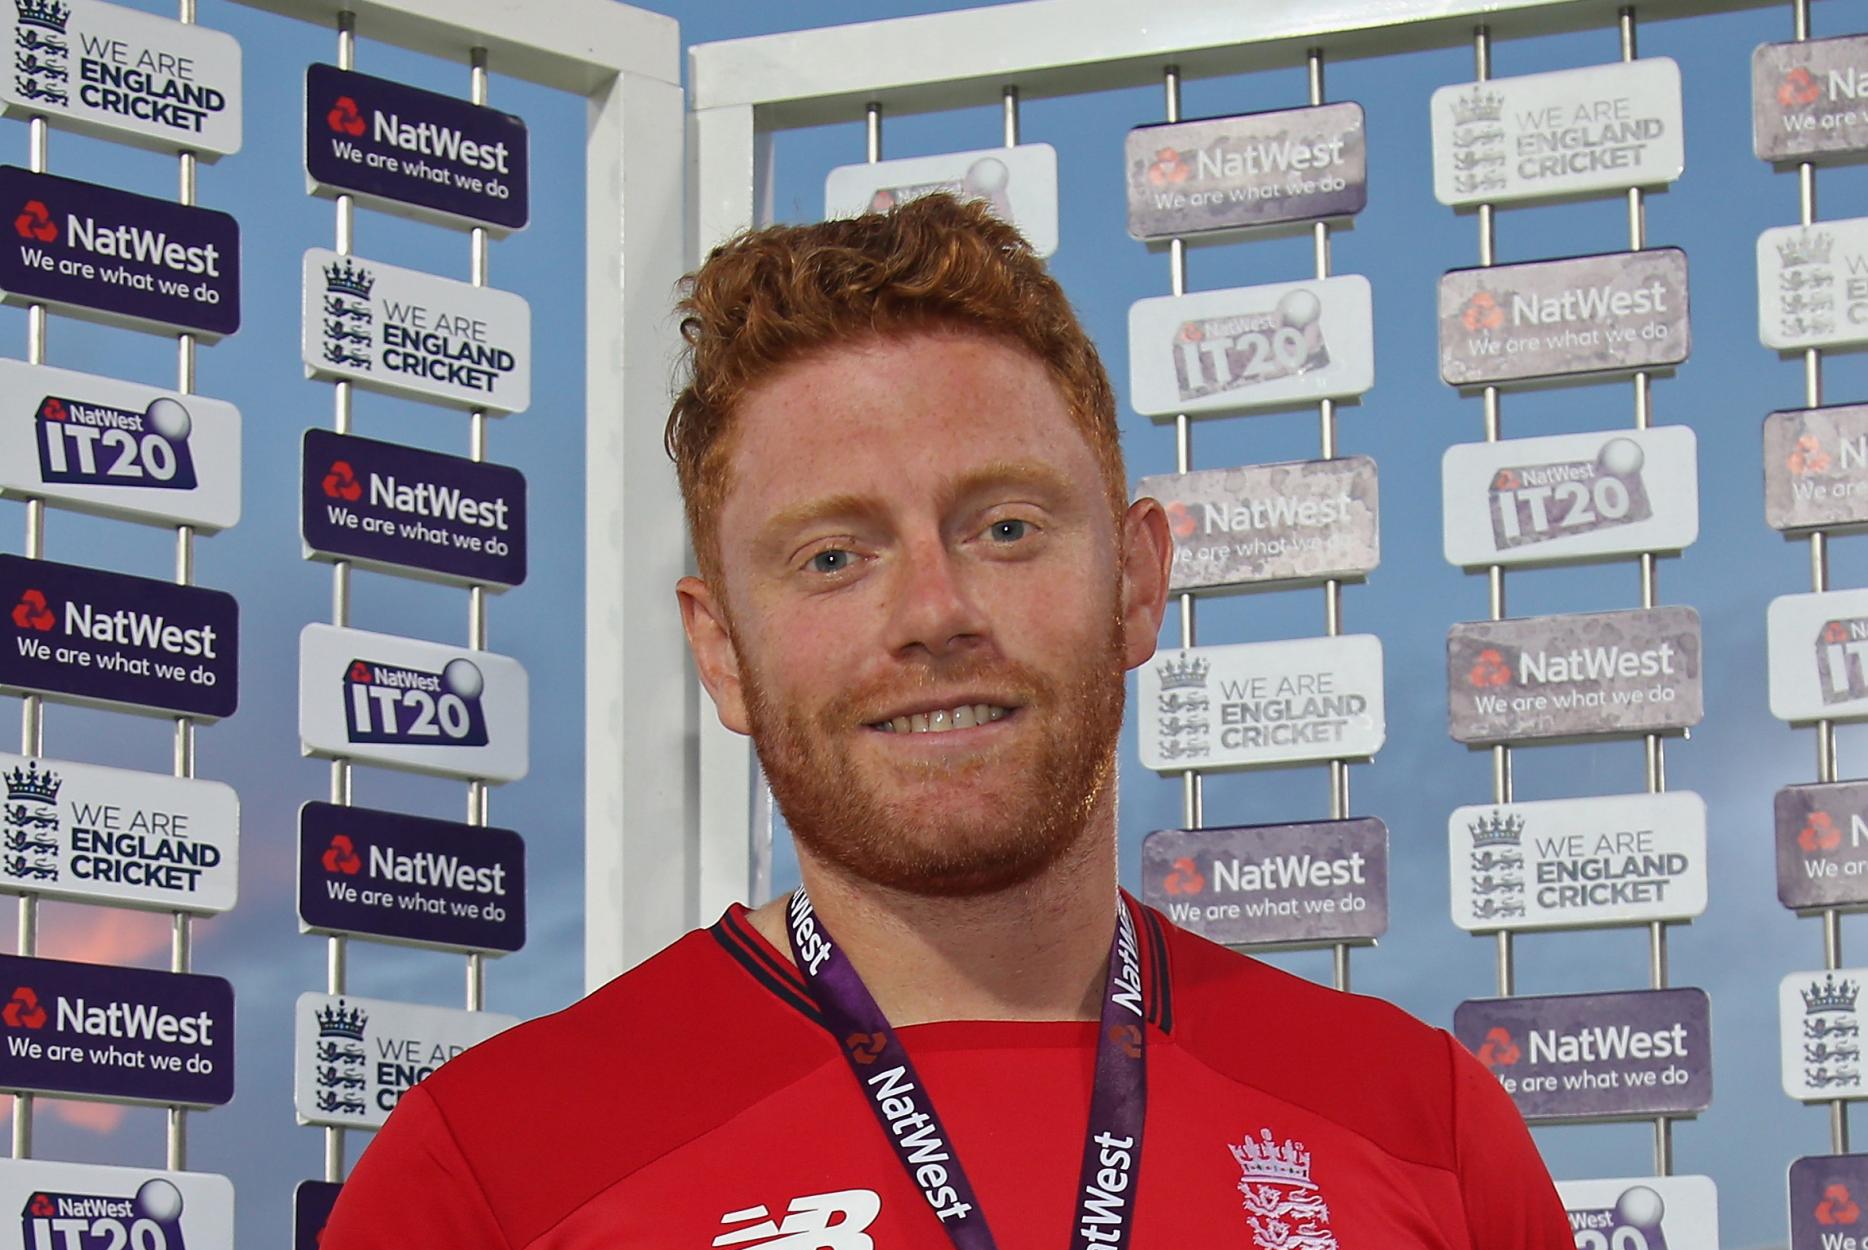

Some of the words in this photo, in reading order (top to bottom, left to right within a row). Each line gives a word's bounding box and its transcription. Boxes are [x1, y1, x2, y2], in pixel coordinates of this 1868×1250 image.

[81, 33, 127, 65] WE
[137, 50, 192, 81] ARE
[80, 58, 224, 112] ENGLAND
[80, 85, 207, 132] CRICKET
[1516, 107, 1562, 129] WE
[1574, 98, 1630, 122] ARE
[1784, 114, 1815, 131] We
[1821, 112, 1857, 129] are
[375, 111, 508, 173] NatWest
[1517, 118, 1664, 154] ENGLAND
[333, 140, 362, 162] We
[367, 153, 398, 171] are
[403, 161, 450, 184] what
[455, 175, 482, 192] we
[486, 179, 508, 198] do
[1199, 139, 1344, 180] NatWest
[1518, 142, 1646, 180] CRICKET
[1155, 189, 1185, 207] We
[1191, 186, 1223, 204] are
[1230, 182, 1281, 202] what
[1287, 179, 1316, 196] we
[1321, 174, 1346, 192] do
[68, 215, 218, 277] NatWest
[21, 247, 54, 270] We
[59, 260, 94, 278] are
[100, 267, 153, 290] what
[159, 280, 189, 297] we
[194, 283, 219, 303] do
[384, 300, 425, 328] WE
[435, 314, 486, 343] ARE
[1514, 282, 1666, 325] NatWest
[1205, 315, 1275, 338] NatWest
[1469, 339, 1500, 356] We
[1506, 338, 1539, 353] are
[1546, 330, 1599, 349] what
[1606, 328, 1636, 343] we
[1642, 321, 1668, 339] do
[383, 323, 514, 371] ENGLAND
[1180, 327, 1309, 391] IT20
[383, 348, 498, 392] CRICKET
[70, 405, 143, 431] NatWest
[46, 422, 176, 480] IT20
[1523, 464, 1594, 485] NatWest
[371, 474, 507, 531] NatWest
[1204, 495, 1353, 532] NatWest
[1499, 477, 1629, 538] IT20
[328, 506, 358, 528] We
[363, 518, 394, 535] are
[400, 522, 449, 545] what
[453, 534, 481, 550] we
[485, 537, 508, 555] do
[1198, 538, 1231, 560] are
[1236, 532, 1288, 556] what
[66, 602, 216, 658] NatWest
[18, 637, 50, 659] We
[56, 649, 90, 666] are
[97, 652, 149, 675] what
[155, 664, 185, 680] we
[190, 666, 215, 685] do
[375, 668, 440, 691] NatWest
[1521, 644, 1674, 683] NatWest
[1221, 680, 1267, 700] WE
[1276, 673, 1333, 697] ARE
[1476, 696, 1507, 714] We
[1512, 697, 1547, 714] are
[1552, 690, 1608, 708] what
[1612, 690, 1643, 705] we
[1649, 684, 1675, 702] do
[353, 684, 469, 737] IT20
[1221, 695, 1366, 724] ENGLAND
[1221, 720, 1347, 749] CRICKET
[72, 802, 120, 829] WE
[129, 811, 187, 838] ARE
[72, 828, 220, 869] ENGLAND
[1536, 836, 1584, 858] WE
[1594, 831, 1653, 855] ARE
[71, 855, 201, 891] CRICKET
[370, 845, 505, 895] NatWest
[1214, 853, 1365, 892] NatWest
[1537, 854, 1688, 884] ENGLAND
[1805, 859, 1838, 878] We
[327, 881, 356, 902] We
[362, 891, 393, 907] are
[398, 893, 446, 914] what
[451, 903, 478, 918] we
[483, 903, 505, 921] do
[1170, 904, 1200, 921] We
[1206, 905, 1240, 920] are
[1246, 898, 1298, 917] what
[1304, 900, 1334, 913] we
[1340, 893, 1365, 911] do
[1537, 880, 1669, 908] CRICKET
[792, 893, 831, 975] West
[1112, 906, 1142, 1016] NatW
[57, 997, 212, 1045] NatWest
[8, 1036, 41, 1058] We
[48, 1046, 83, 1062] are
[90, 1046, 144, 1072] what
[150, 1055, 181, 1071] we
[187, 1054, 212, 1073] do
[377, 1038, 420, 1063] WE
[1530, 1024, 1687, 1063] NatWest
[1522, 1077, 1557, 1092] are
[1564, 1070, 1618, 1089] what
[1625, 1072, 1656, 1086] we
[1662, 1065, 1688, 1084] do
[868, 1066, 971, 1222] NatWest
[58, 1199, 133, 1217] NatWest
[1568, 1211, 1613, 1229] West
